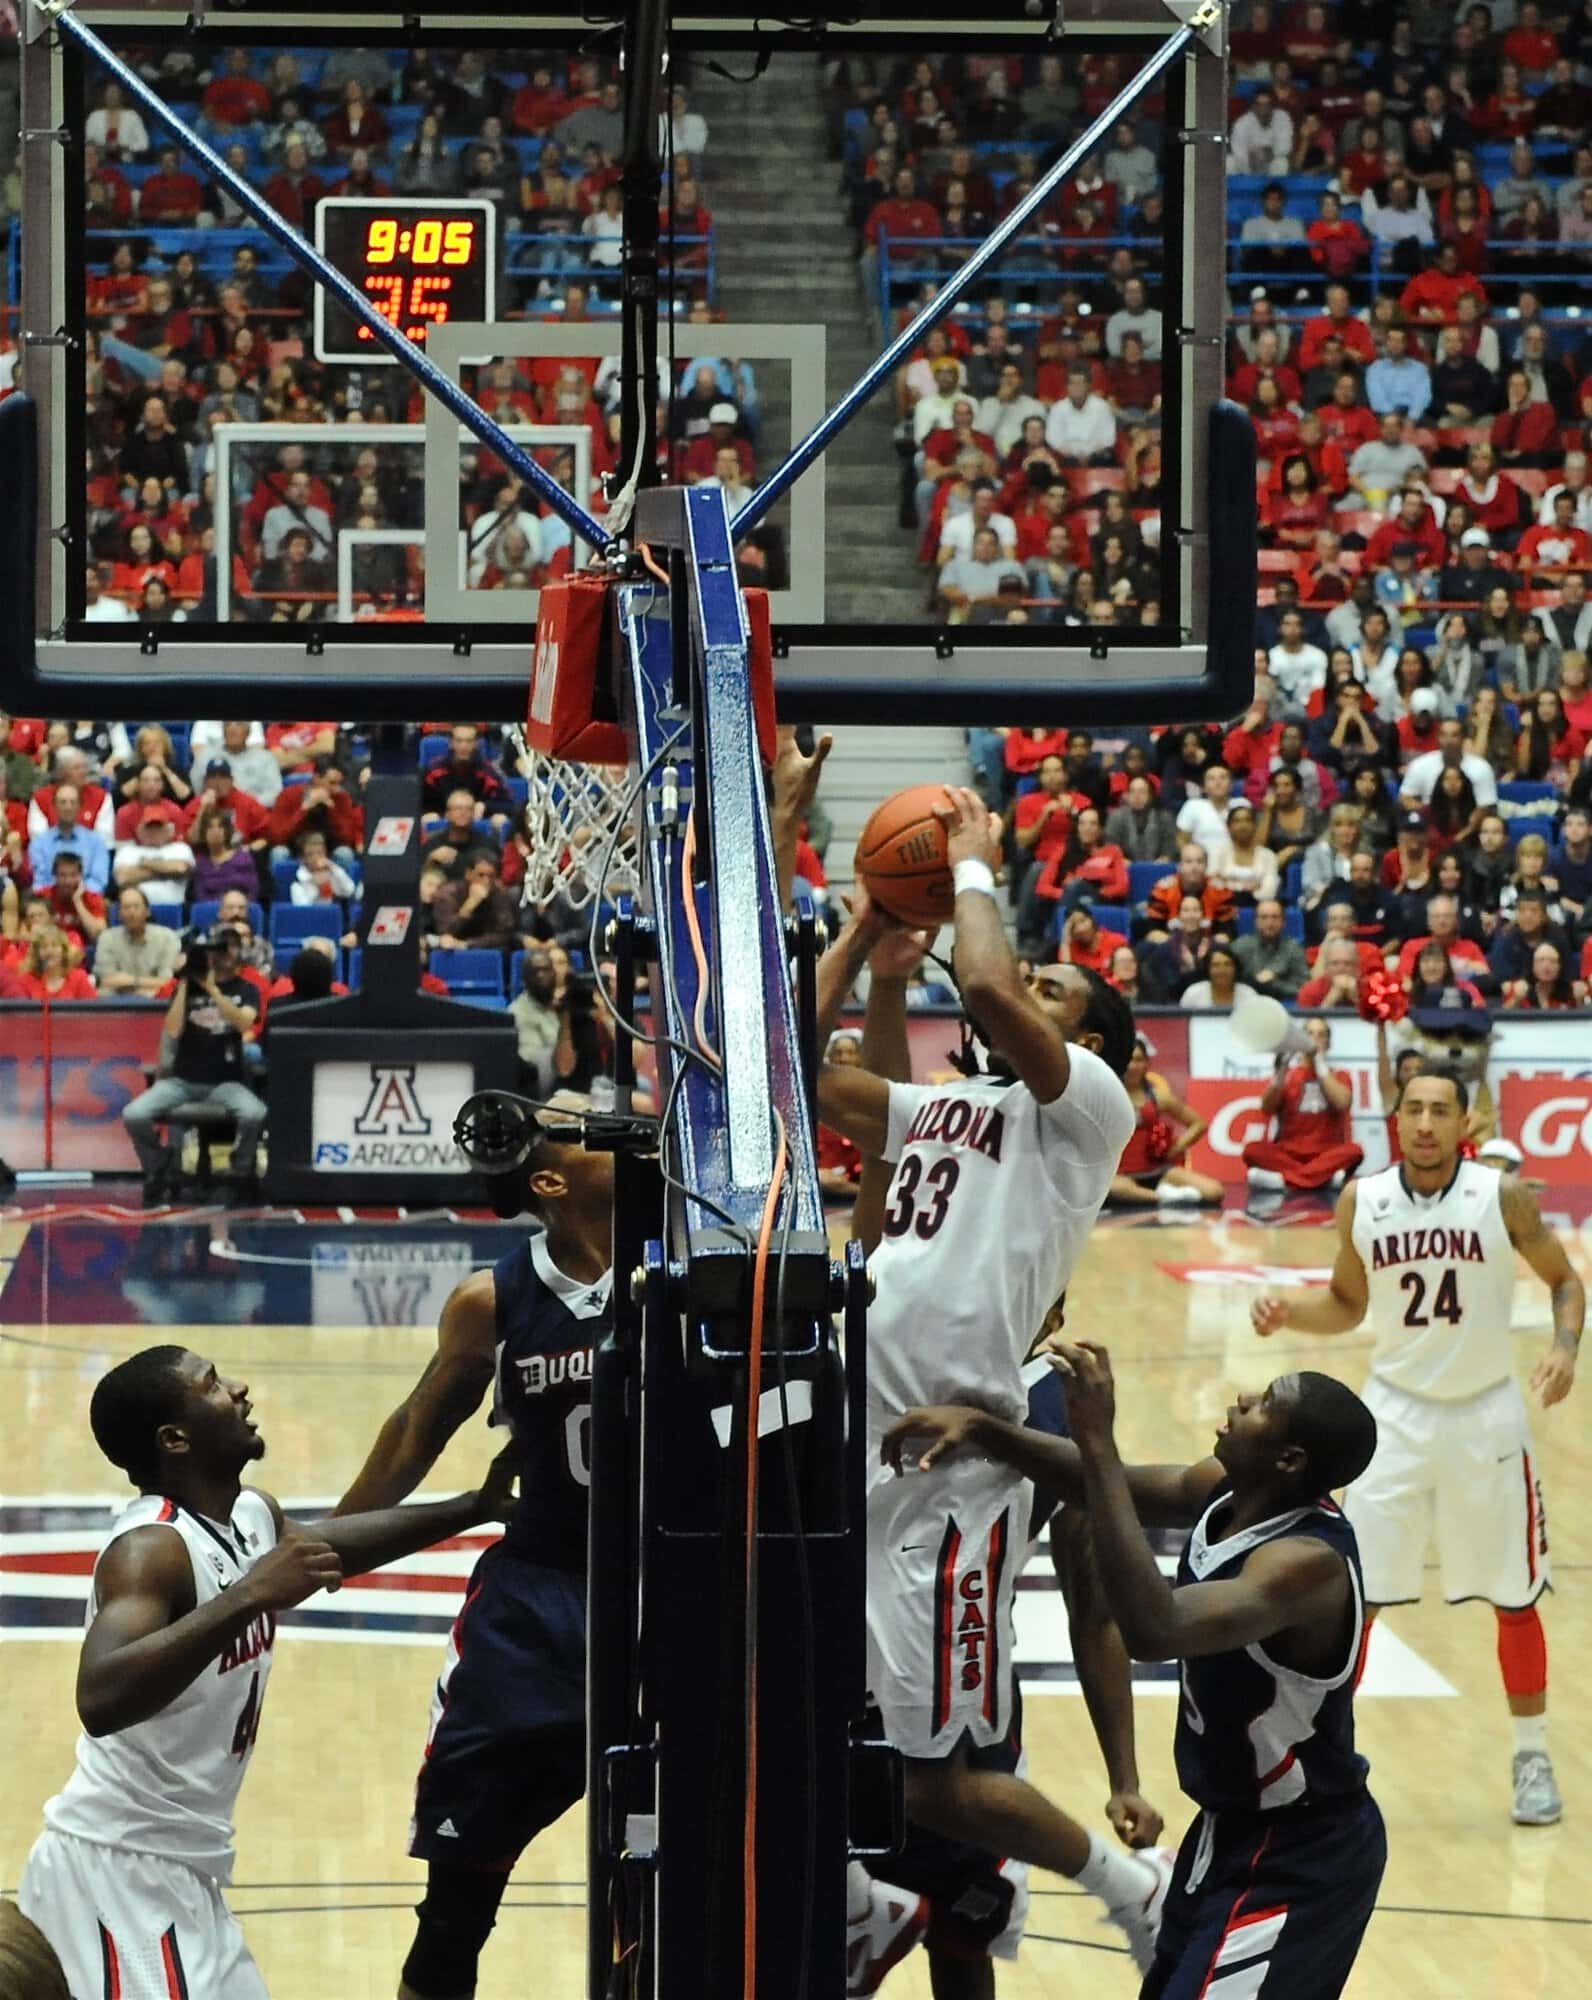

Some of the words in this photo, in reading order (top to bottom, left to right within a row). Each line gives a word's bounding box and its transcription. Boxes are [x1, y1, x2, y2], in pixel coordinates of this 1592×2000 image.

[366, 220, 473, 264] 9:05
[896, 829, 939, 864] THE
[354, 1063, 431, 1135] A
[1208, 1095, 1280, 1157] G
[1520, 1097, 1592, 1157] G
[316, 1143, 348, 1165] FS
[352, 1142, 464, 1166] ARIZONA
[882, 1153, 960, 1240] 33
[1373, 1228, 1484, 1270] ARIZONA
[1401, 1269, 1463, 1327] 24
[957, 1570, 986, 1691] CATS
